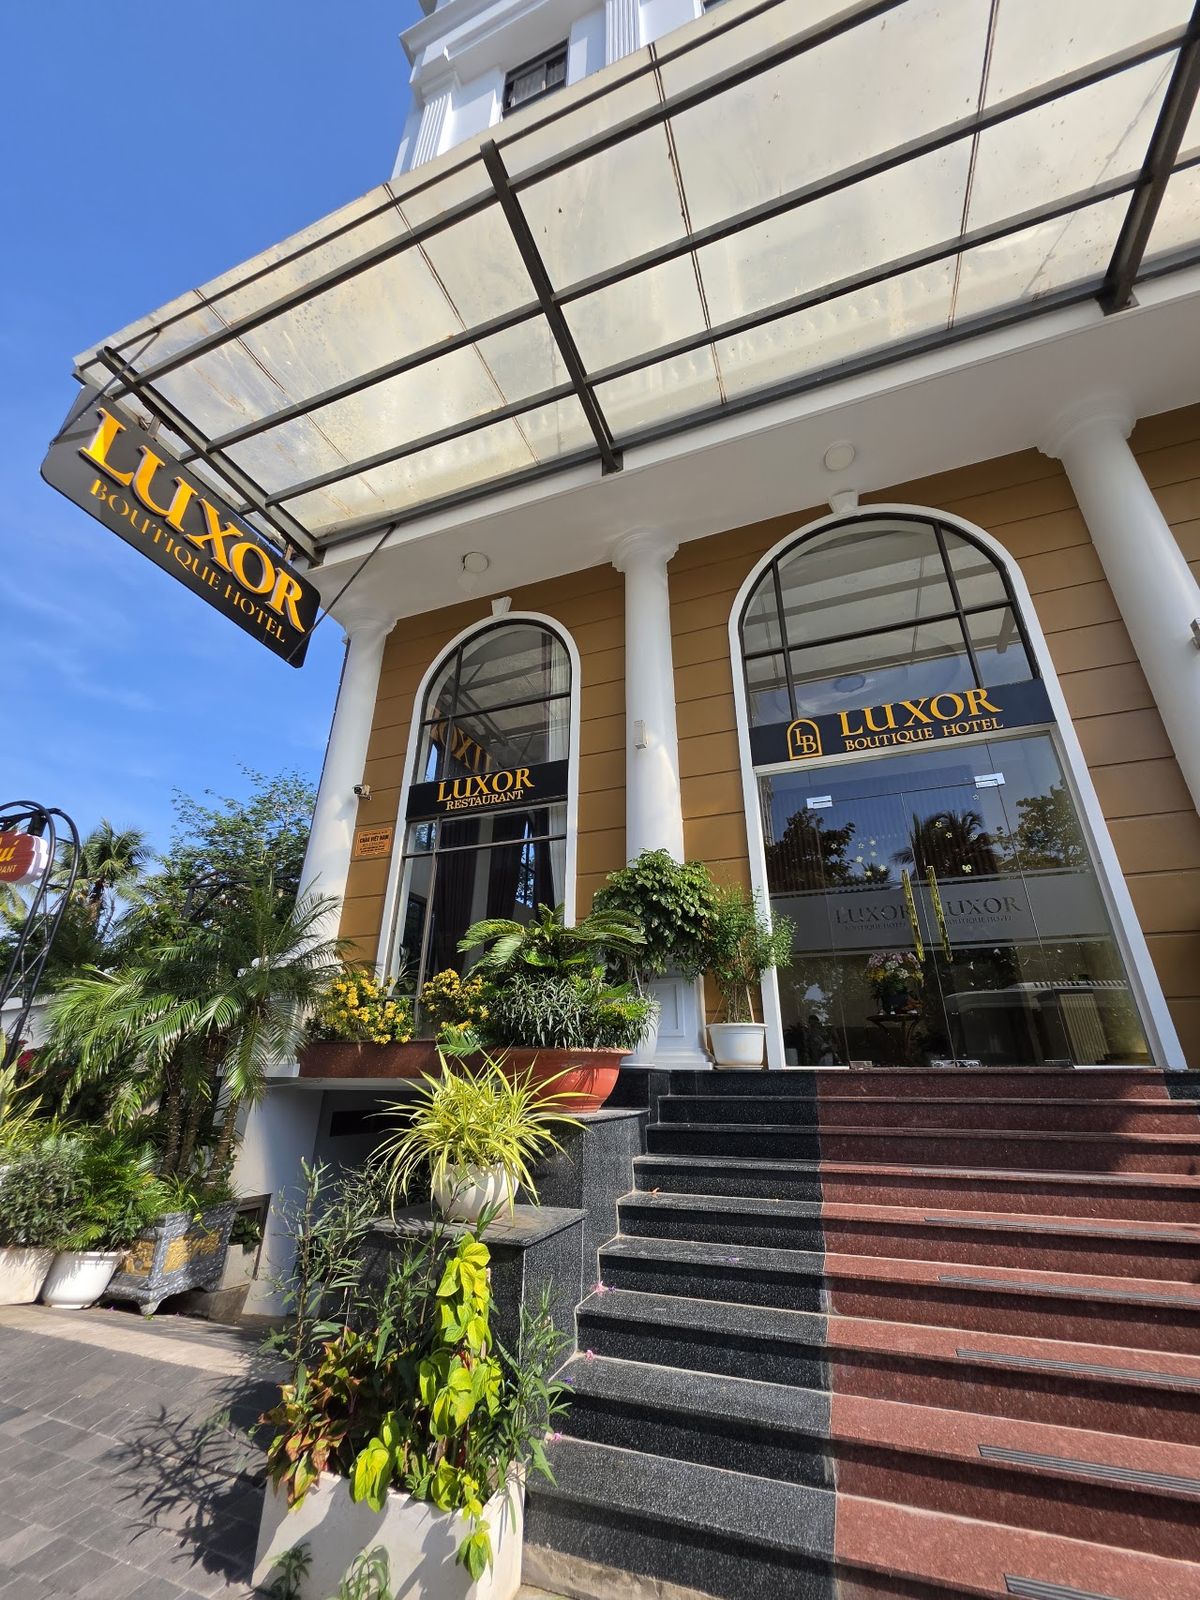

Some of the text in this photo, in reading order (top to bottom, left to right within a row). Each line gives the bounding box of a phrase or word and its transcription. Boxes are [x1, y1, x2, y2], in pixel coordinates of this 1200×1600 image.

[78, 407, 305, 633] LUXOR
[89, 479, 286, 643] BOUTIQUE HOTEL
[837, 688, 1004, 737] LUXOR
[845, 717, 1004, 752] BOUTIQUE HOTEL
[437, 768, 535, 802] LUXOR
[445, 789, 524, 811] RESTAURANT
[942, 897, 1022, 917] UXOR
